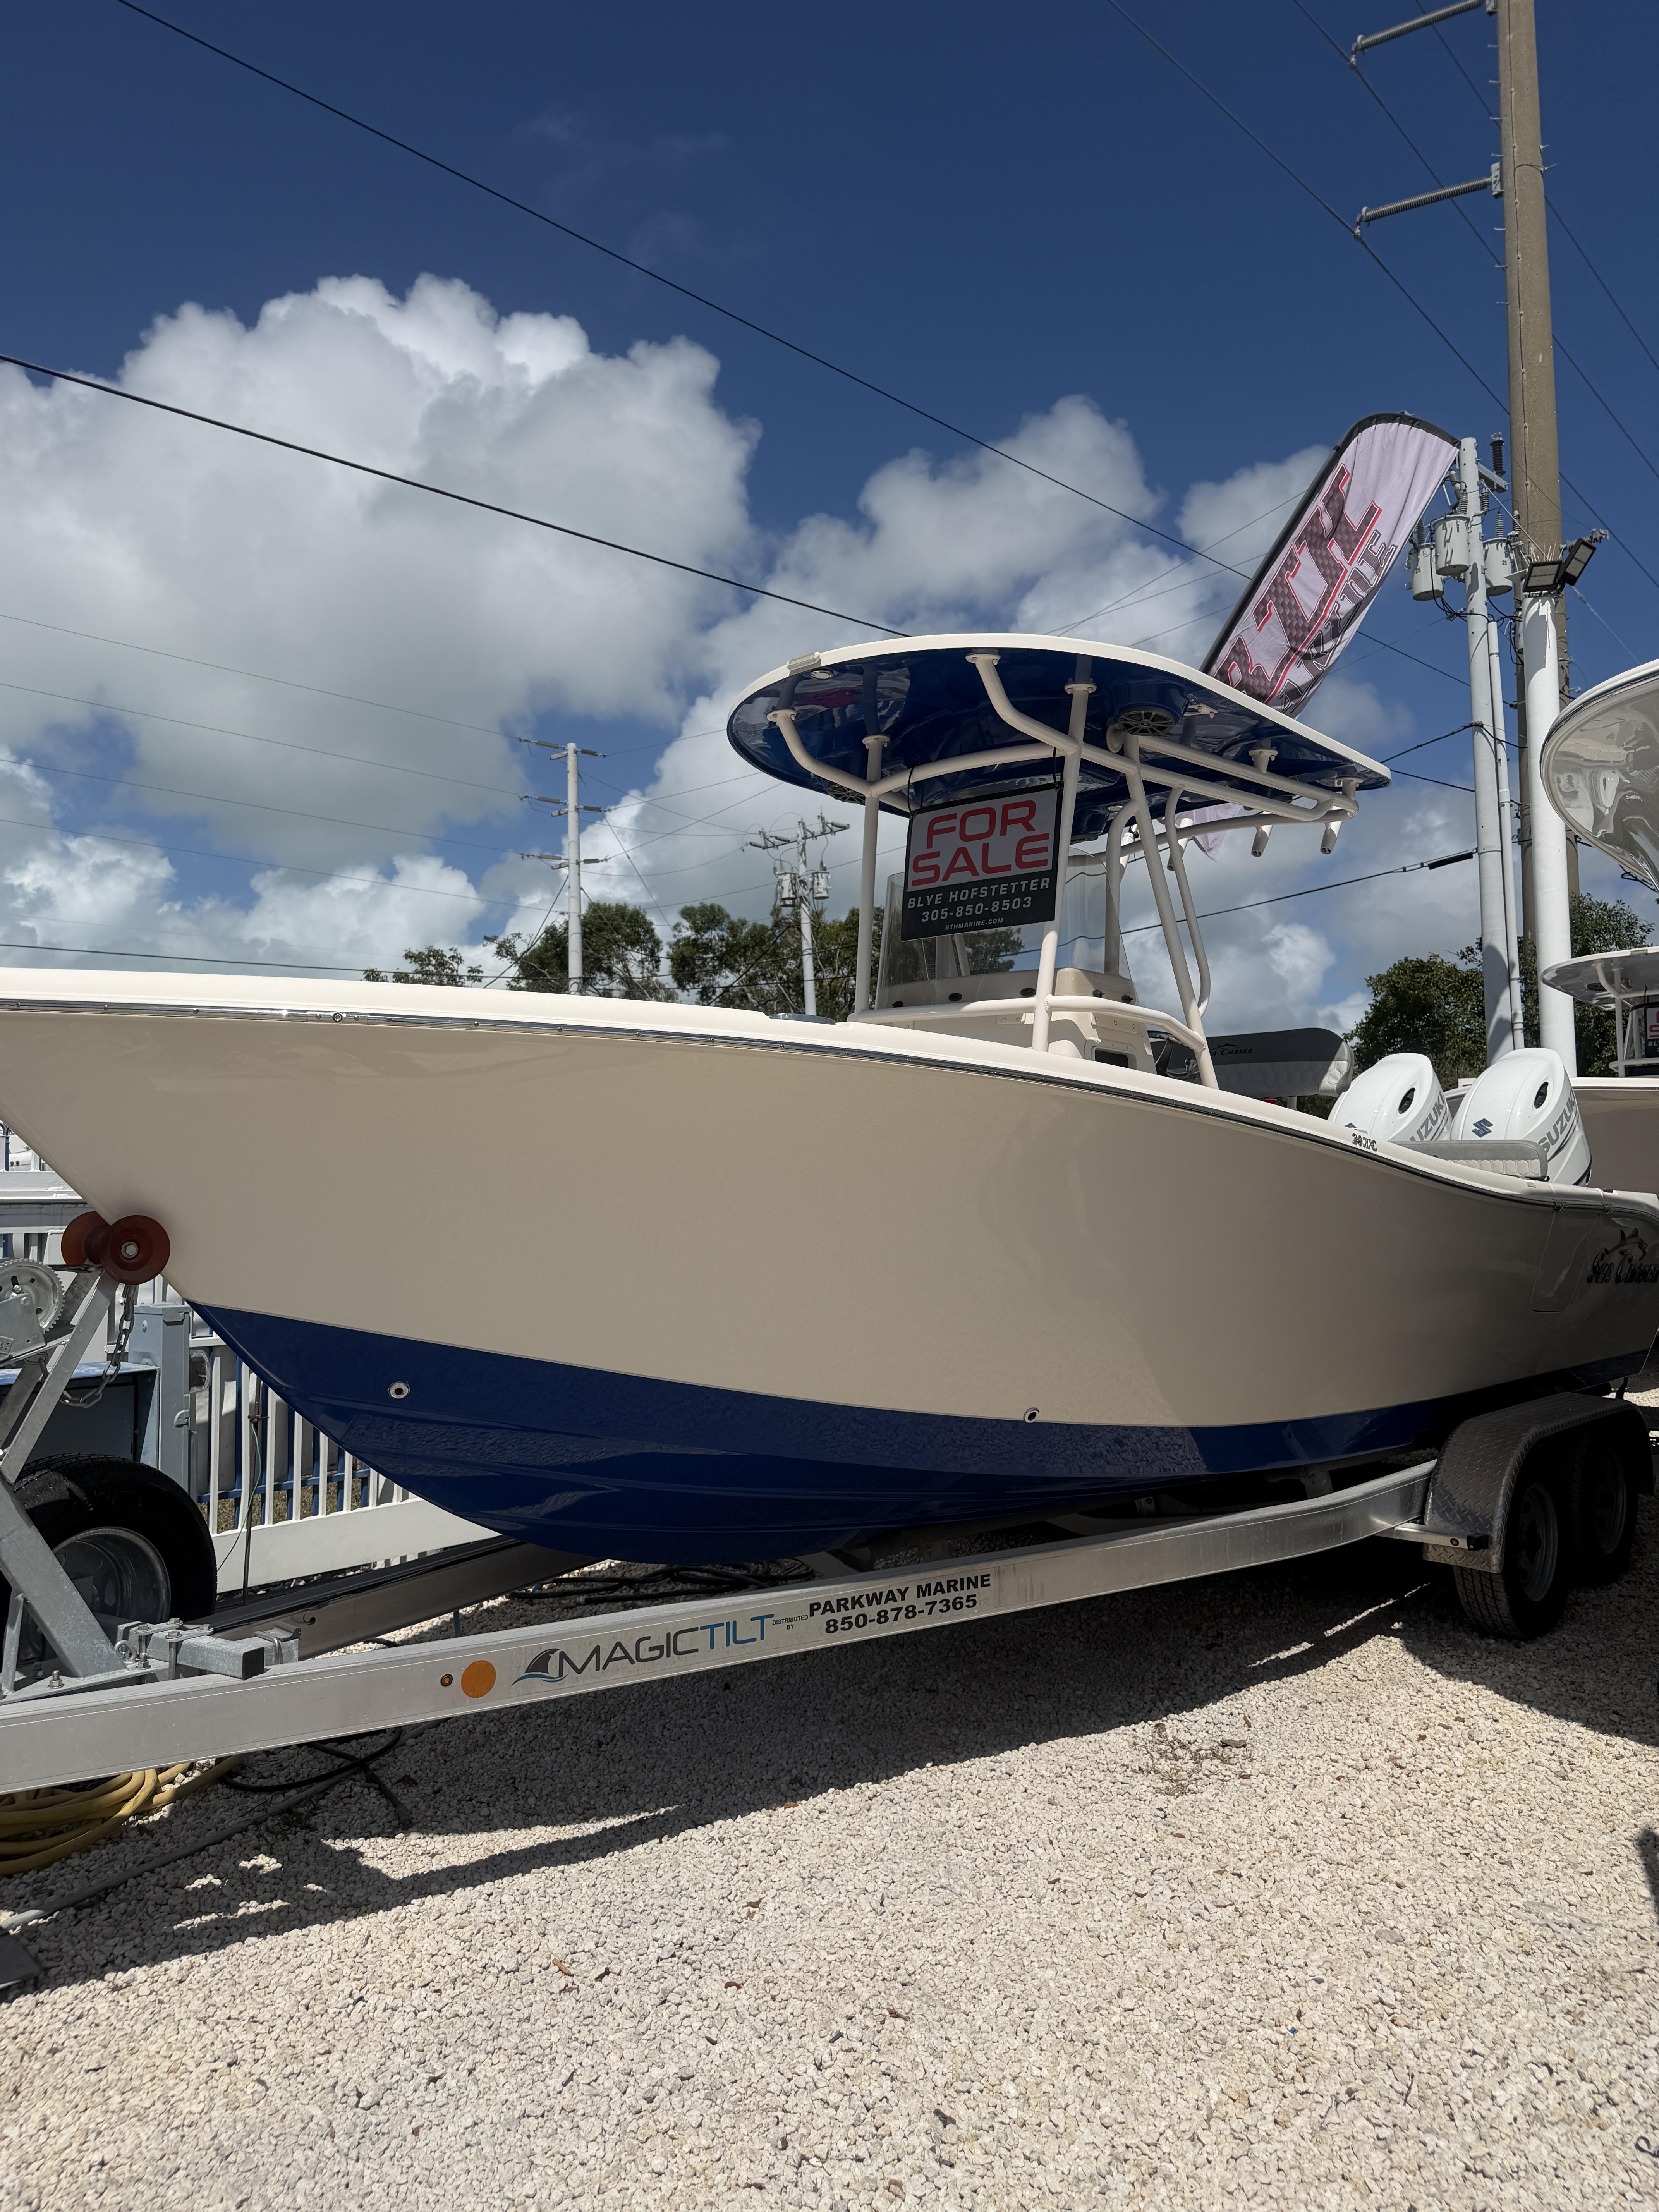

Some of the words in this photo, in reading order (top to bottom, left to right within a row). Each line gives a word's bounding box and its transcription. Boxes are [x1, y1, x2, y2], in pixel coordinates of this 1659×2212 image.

[1278, 529, 1398, 713] ARINE
[926, 800, 1036, 849] FOR
[911, 833, 1050, 887] SALE
[907, 893, 943, 909] BLYE
[949, 877, 1050, 902] HOFSTETTER
[921, 896, 1032, 922] 305-850-8503
[945, 917, 1004, 931] BTHMARINE.COM
[1409, 1091, 1445, 1141] UZUKI
[809, 1587, 910, 1617] PARKWAY
[916, 1573, 991, 1599] MARINE
[825, 1594, 977, 1634] 850-878-7365
[772, 1614, 809, 1625] DISTRIBUTED
[558, 1614, 775, 1678] MAGICTILT
